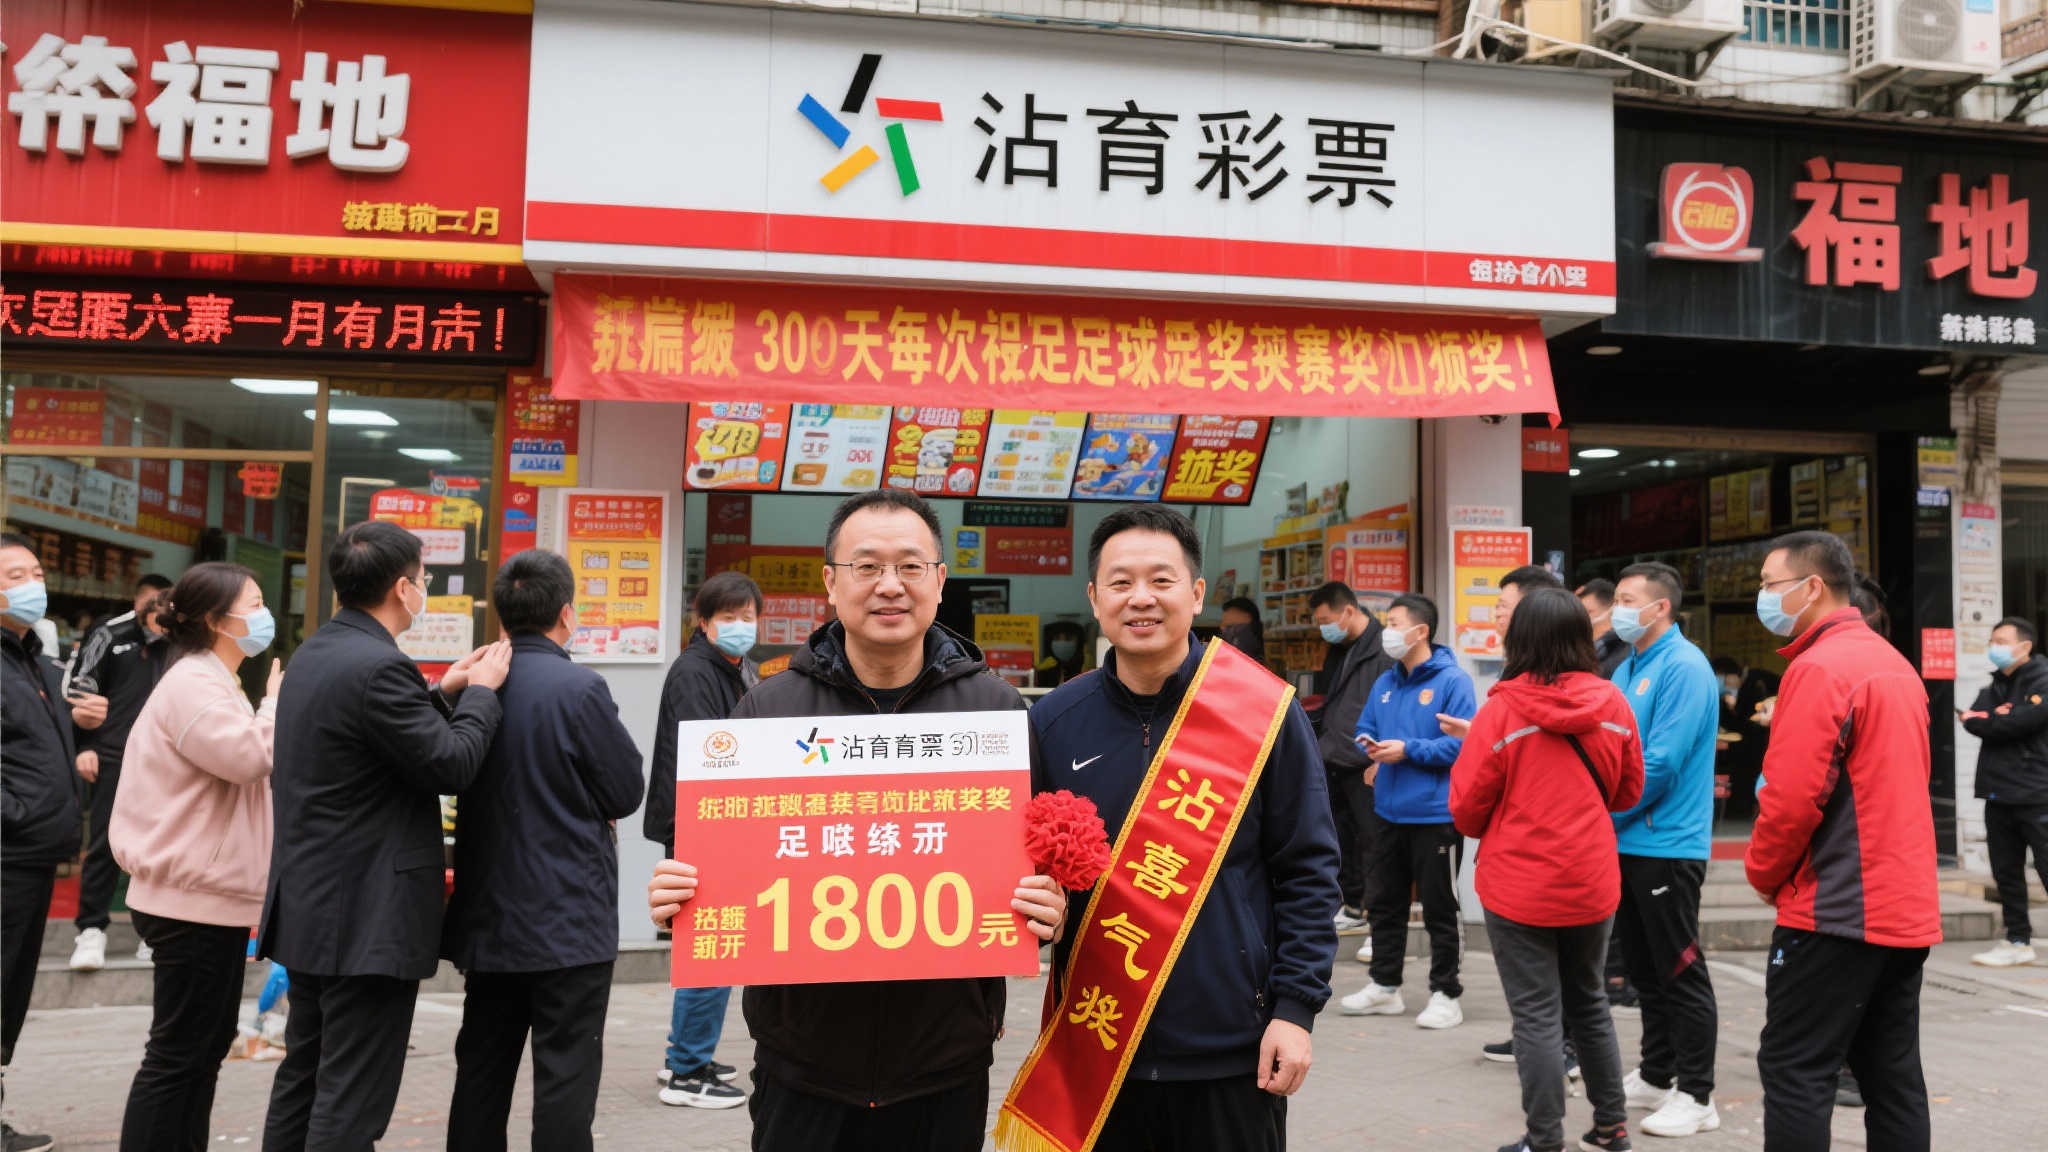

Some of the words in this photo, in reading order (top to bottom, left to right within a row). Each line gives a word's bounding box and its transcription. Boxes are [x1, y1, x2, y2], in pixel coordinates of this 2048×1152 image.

[974, 92, 1396, 208] 沾育彩票
[1790, 156, 2038, 299] 福地
